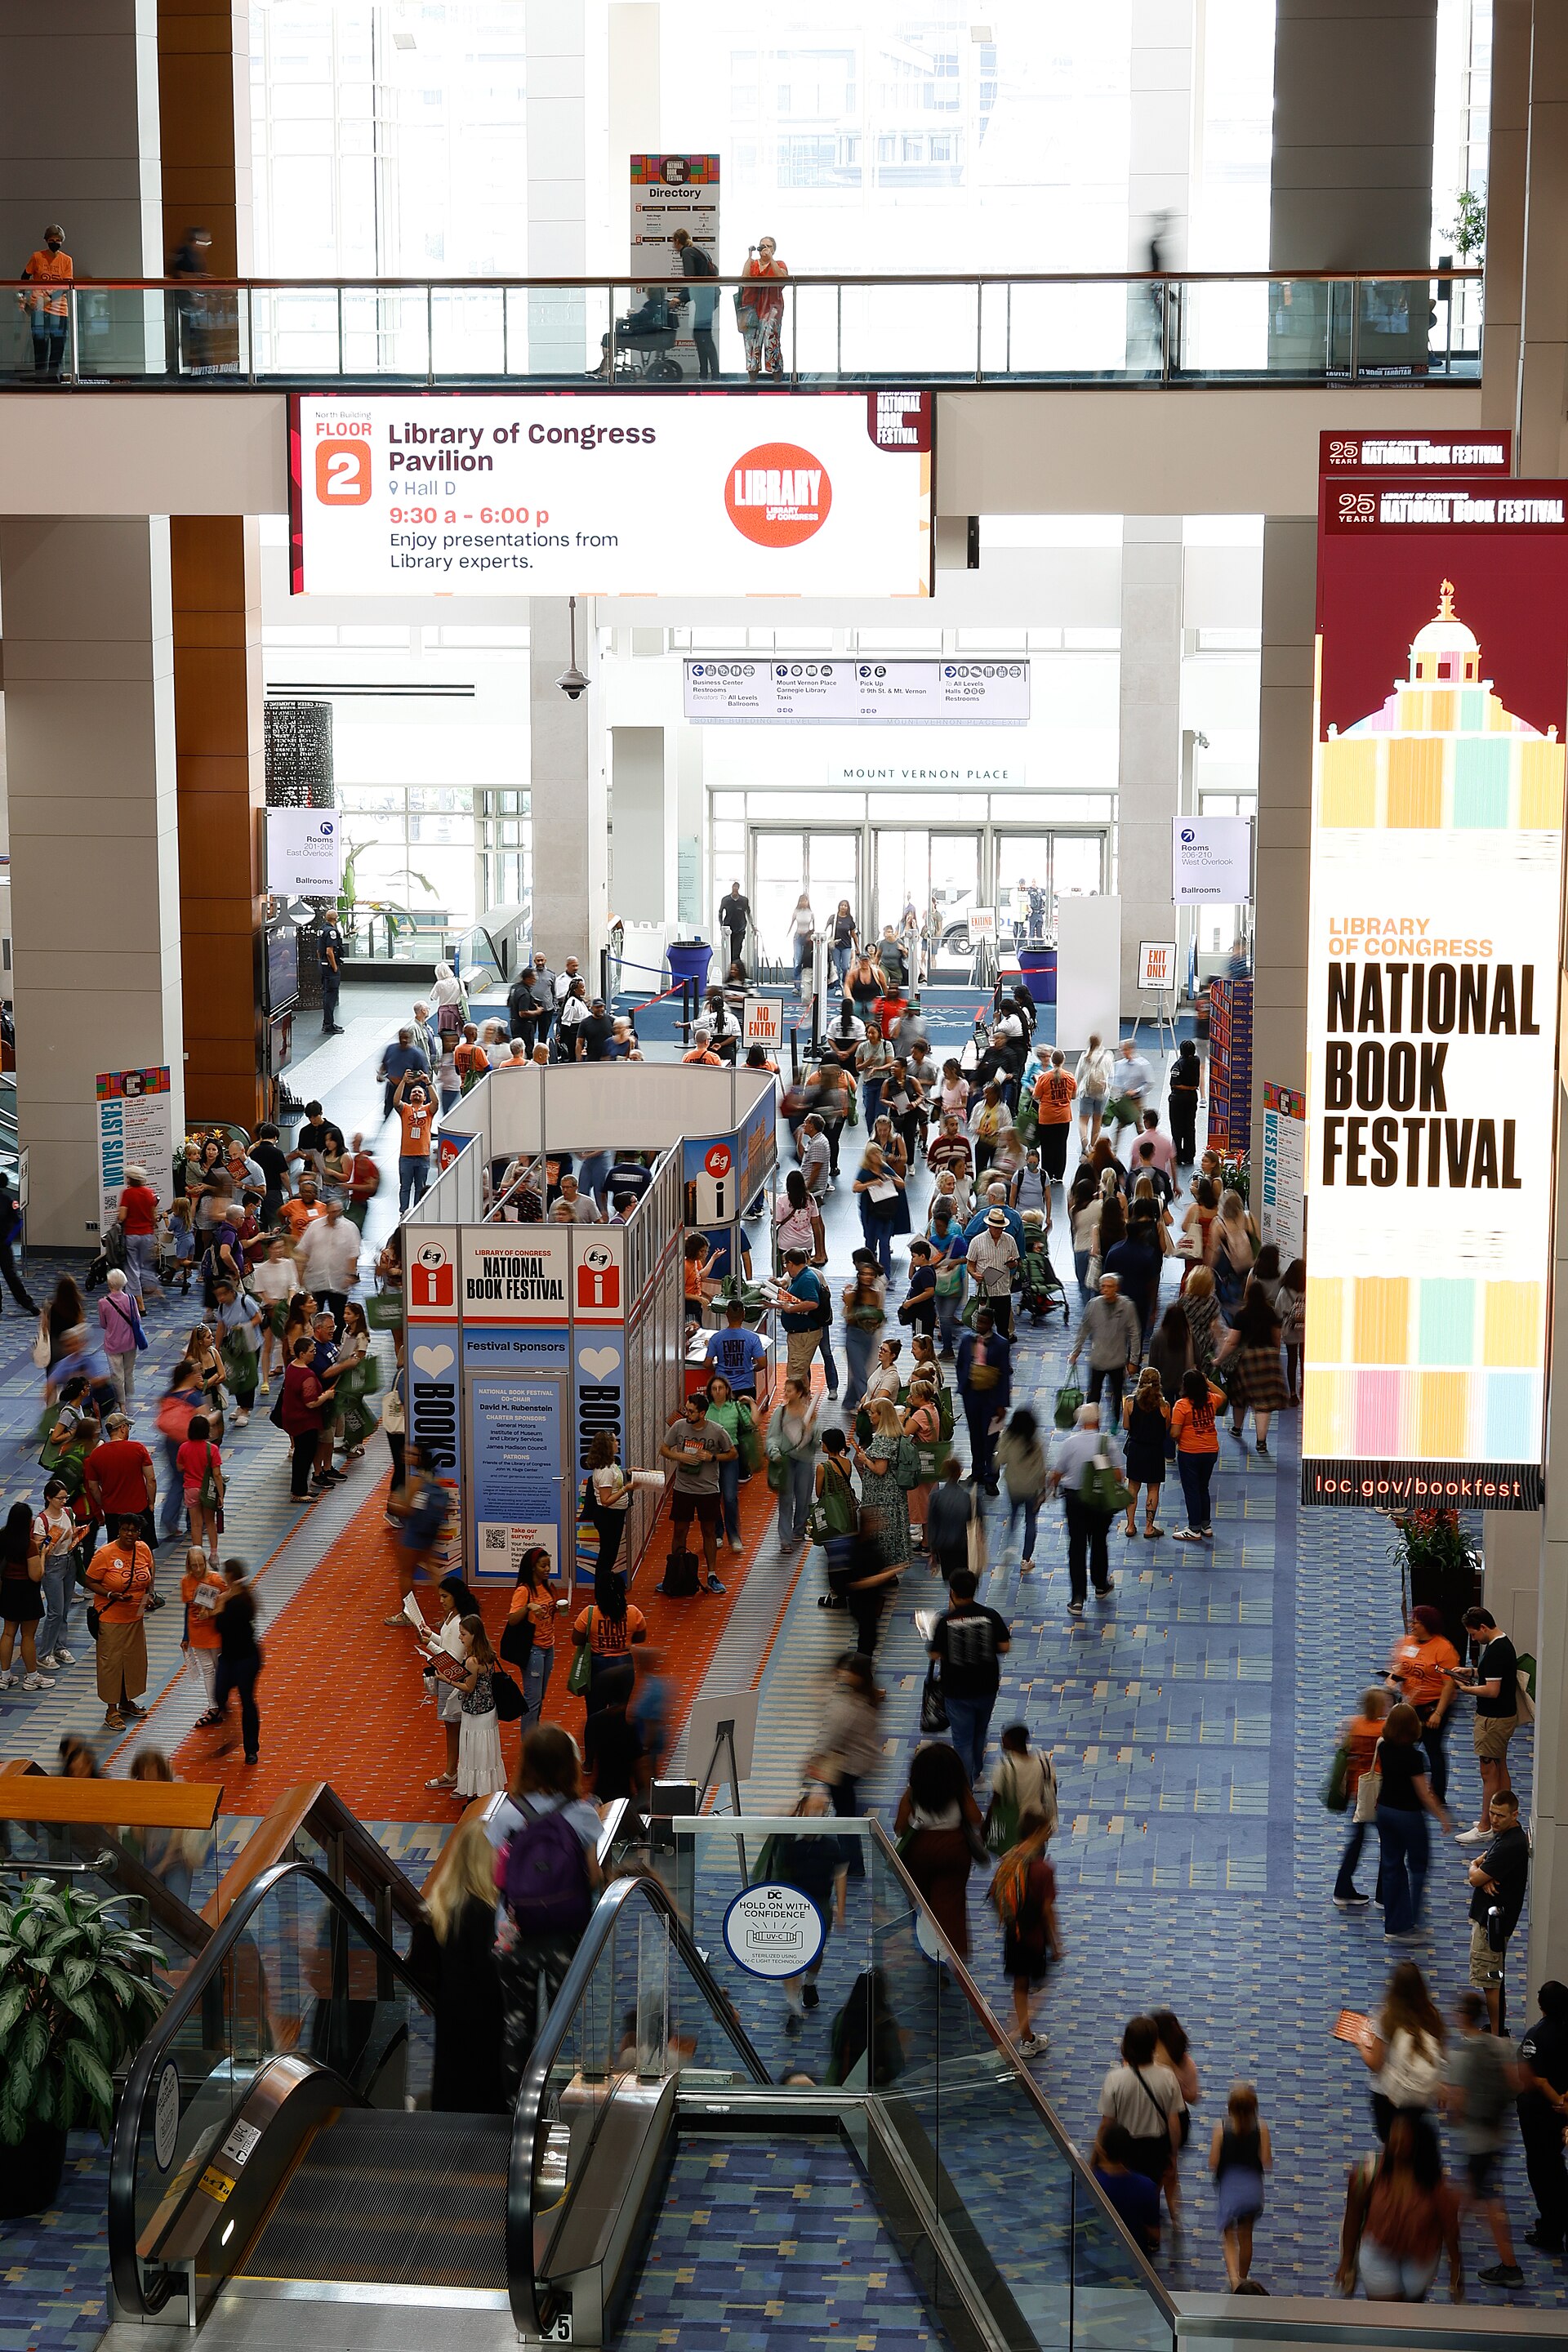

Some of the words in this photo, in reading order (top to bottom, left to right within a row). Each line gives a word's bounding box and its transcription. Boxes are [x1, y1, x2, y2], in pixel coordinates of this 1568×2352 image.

[649, 188, 702, 199] Directory
[876, 396, 921, 412] NATIONAL
[340, 411, 372, 420] Building
[876, 412, 904, 428] BOOK
[316, 422, 372, 436] FLOOR
[389, 422, 484, 449] Library
[492, 422, 520, 444] of
[528, 424, 656, 450] Congress
[876, 427, 919, 444] FESTIVAL
[1330, 441, 1358, 459] 25
[1361, 446, 1417, 465] NATIONAL
[1417, 446, 1451, 464] BOOK
[1452, 445, 1505, 464] FESTIVAL
[389, 450, 493, 472] Pavilion
[327, 452, 361, 495] 2
[404, 480, 438, 496] Hall
[445, 481, 456, 496] D
[734, 470, 822, 507] LIBRARY
[766, 506, 800, 514] LIBRARY
[1339, 493, 1375, 514] 25
[1380, 500, 1451, 523] NATIONAL
[1452, 500, 1495, 523] BOOK
[1497, 500, 1566, 523] FESTIVAL
[390, 507, 438, 524] 9:30
[444, 510, 457, 524] a
[480, 507, 529, 524] 6:00
[536, 511, 550, 528] p
[390, 532, 437, 550] Enjoy
[443, 532, 571, 550] presentations
[575, 532, 619, 547] from
[390, 553, 453, 572] Library
[459, 555, 533, 572] experts.
[844, 768, 895, 779] MOUNT
[902, 768, 960, 779] VERNON
[967, 769, 1009, 779] PLACE
[302, 849, 334, 858] Overlook
[971, 916, 992, 927] EXITING
[1329, 917, 1431, 936] LIBRARY
[1328, 938, 1359, 956] OF
[1365, 938, 1494, 957] CONGRESS
[1148, 950, 1167, 964] EXIT
[1147, 964, 1167, 978] ONLY
[1326, 962, 1540, 1035] NATIONAL
[756, 1006, 769, 1021] NO
[748, 1022, 777, 1036] ENTRY
[1325, 1040, 1450, 1112] BOOK
[100, 1101, 122, 1137] EAST
[1264, 1113, 1279, 1156] WEST
[1322, 1116, 1522, 1189] FESTIVAL
[101, 1139, 124, 1187] SALON
[1263, 1156, 1277, 1208] SALON
[483, 1257, 545, 1278] NATIONAL
[466, 1278, 502, 1300] BOOK
[506, 1279, 564, 1300] FESTIVAL
[467, 1341, 510, 1351] Festival
[513, 1342, 566, 1353] Sponsors
[723, 1339, 746, 1353] EVENT
[724, 1353, 744, 1367] STAFF
[1316, 1475, 1521, 1498] loc.gov/bookfest
[442, 1663, 463, 1678] 25
[767, 1891, 782, 1900] DC
[739, 1901, 766, 1909] HOLD
[768, 1902, 783, 1910] ON
[786, 1903, 811, 1911] WITH
[744, 1909, 806, 1918] CONFIDENCE
[231, 2124, 248, 2142] UV-C
